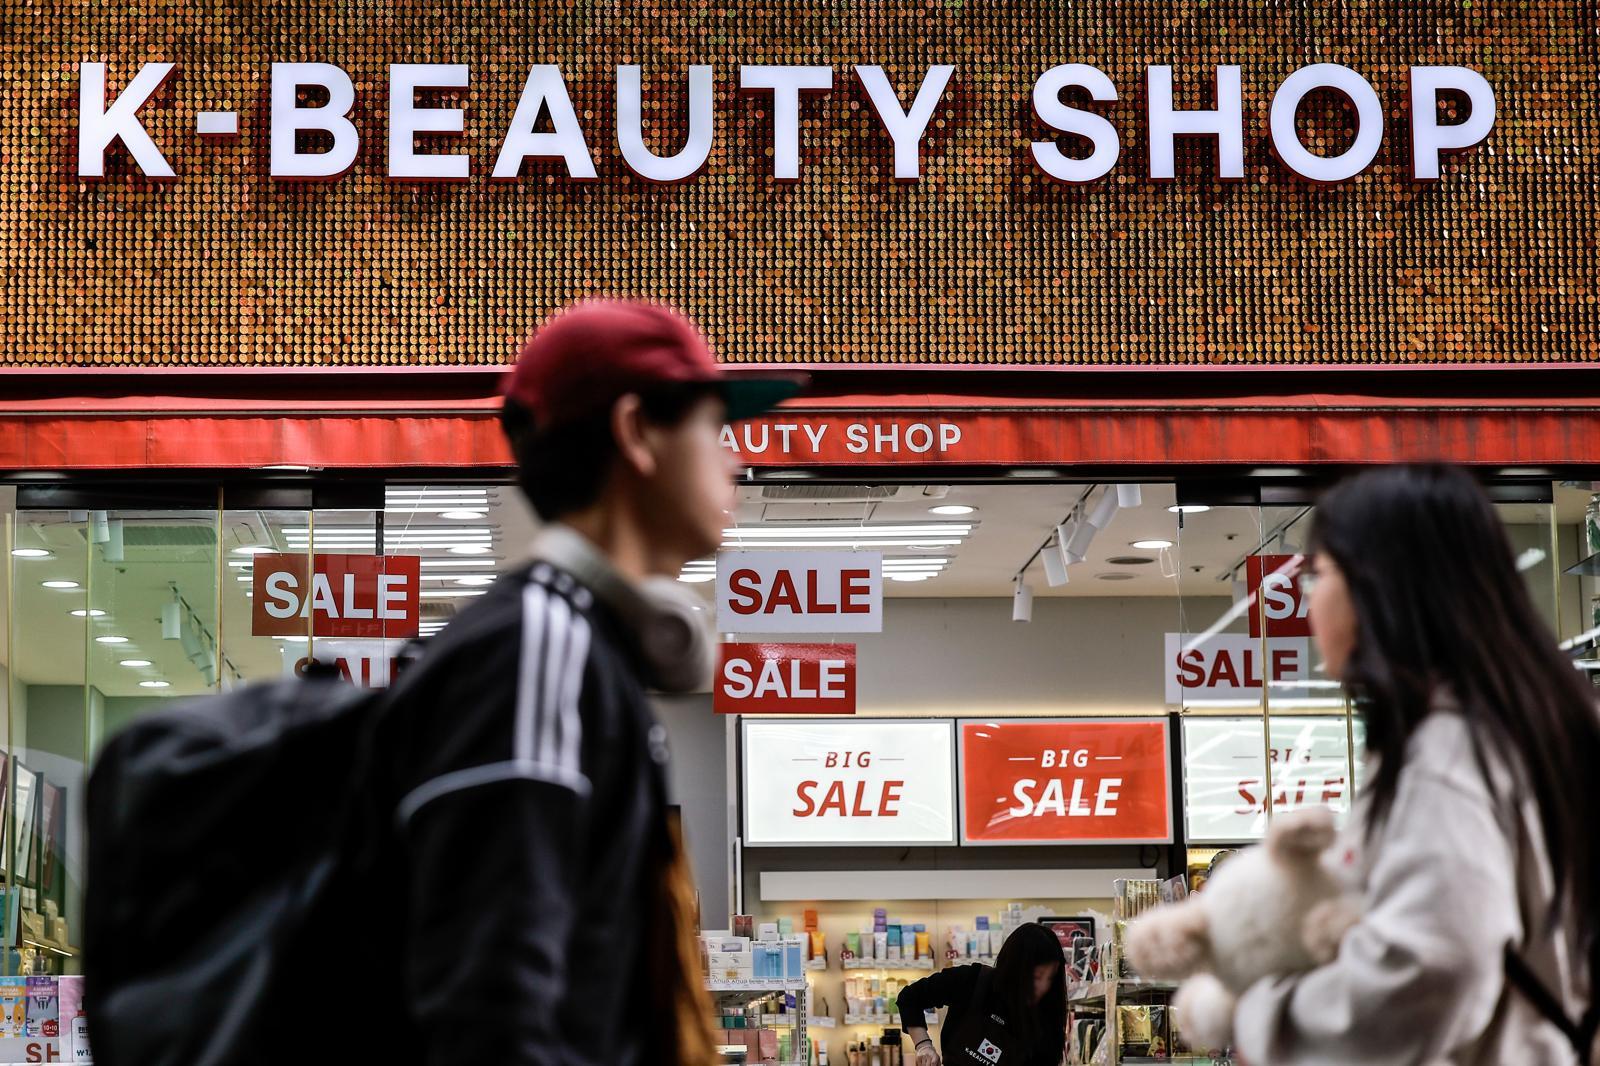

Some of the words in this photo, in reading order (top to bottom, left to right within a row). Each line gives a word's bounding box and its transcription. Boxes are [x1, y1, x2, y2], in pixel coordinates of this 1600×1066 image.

[78, 62, 955, 183] K-BEAUTY
[1031, 62, 1497, 184] SHOP
[717, 423, 828, 454] AUTY
[846, 423, 962, 454] SHOP
[264, 571, 408, 620] SALE
[728, 568, 871, 616] SALE
[723, 657, 846, 699] SALE
[1175, 649, 1299, 688] SALE
[825, 750, 872, 769] BIG
[1041, 749, 1089, 768] BIG
[792, 780, 905, 818] SALE
[1009, 777, 1123, 817] SALE
